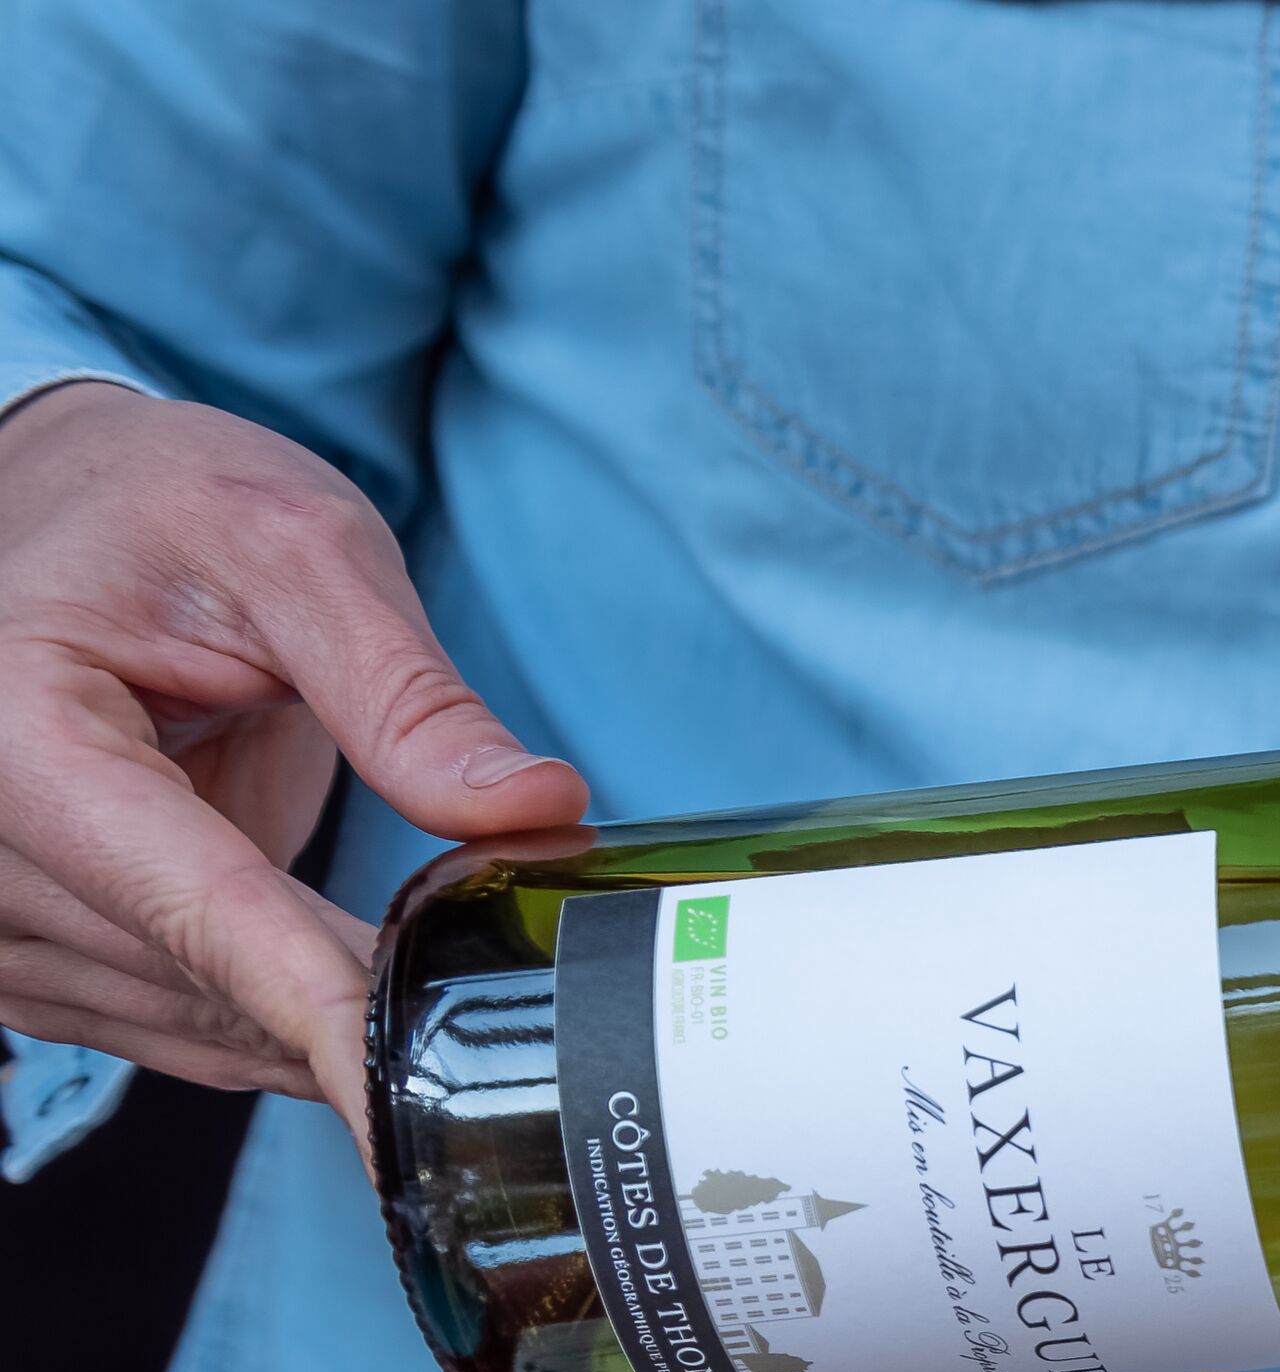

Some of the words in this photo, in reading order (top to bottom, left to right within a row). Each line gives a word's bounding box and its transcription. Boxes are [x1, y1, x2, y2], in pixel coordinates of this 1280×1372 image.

[709, 965, 727, 997] VIN
[710, 1006, 728, 1040] BIO
[901, 1066, 946, 1134] Mis
[912, 1141, 928, 1176] en
[608, 1091, 659, 1230] CÔTES
[636, 1241, 677, 1295] DE
[587, 1138, 620, 1243] INDICATION
[611, 1247, 662, 1361] GÉOGRAPHIQUE
[919, 1182, 975, 1284] bouteille
[1071, 1227, 1116, 1281] LE
[953, 1304, 990, 1326] la
